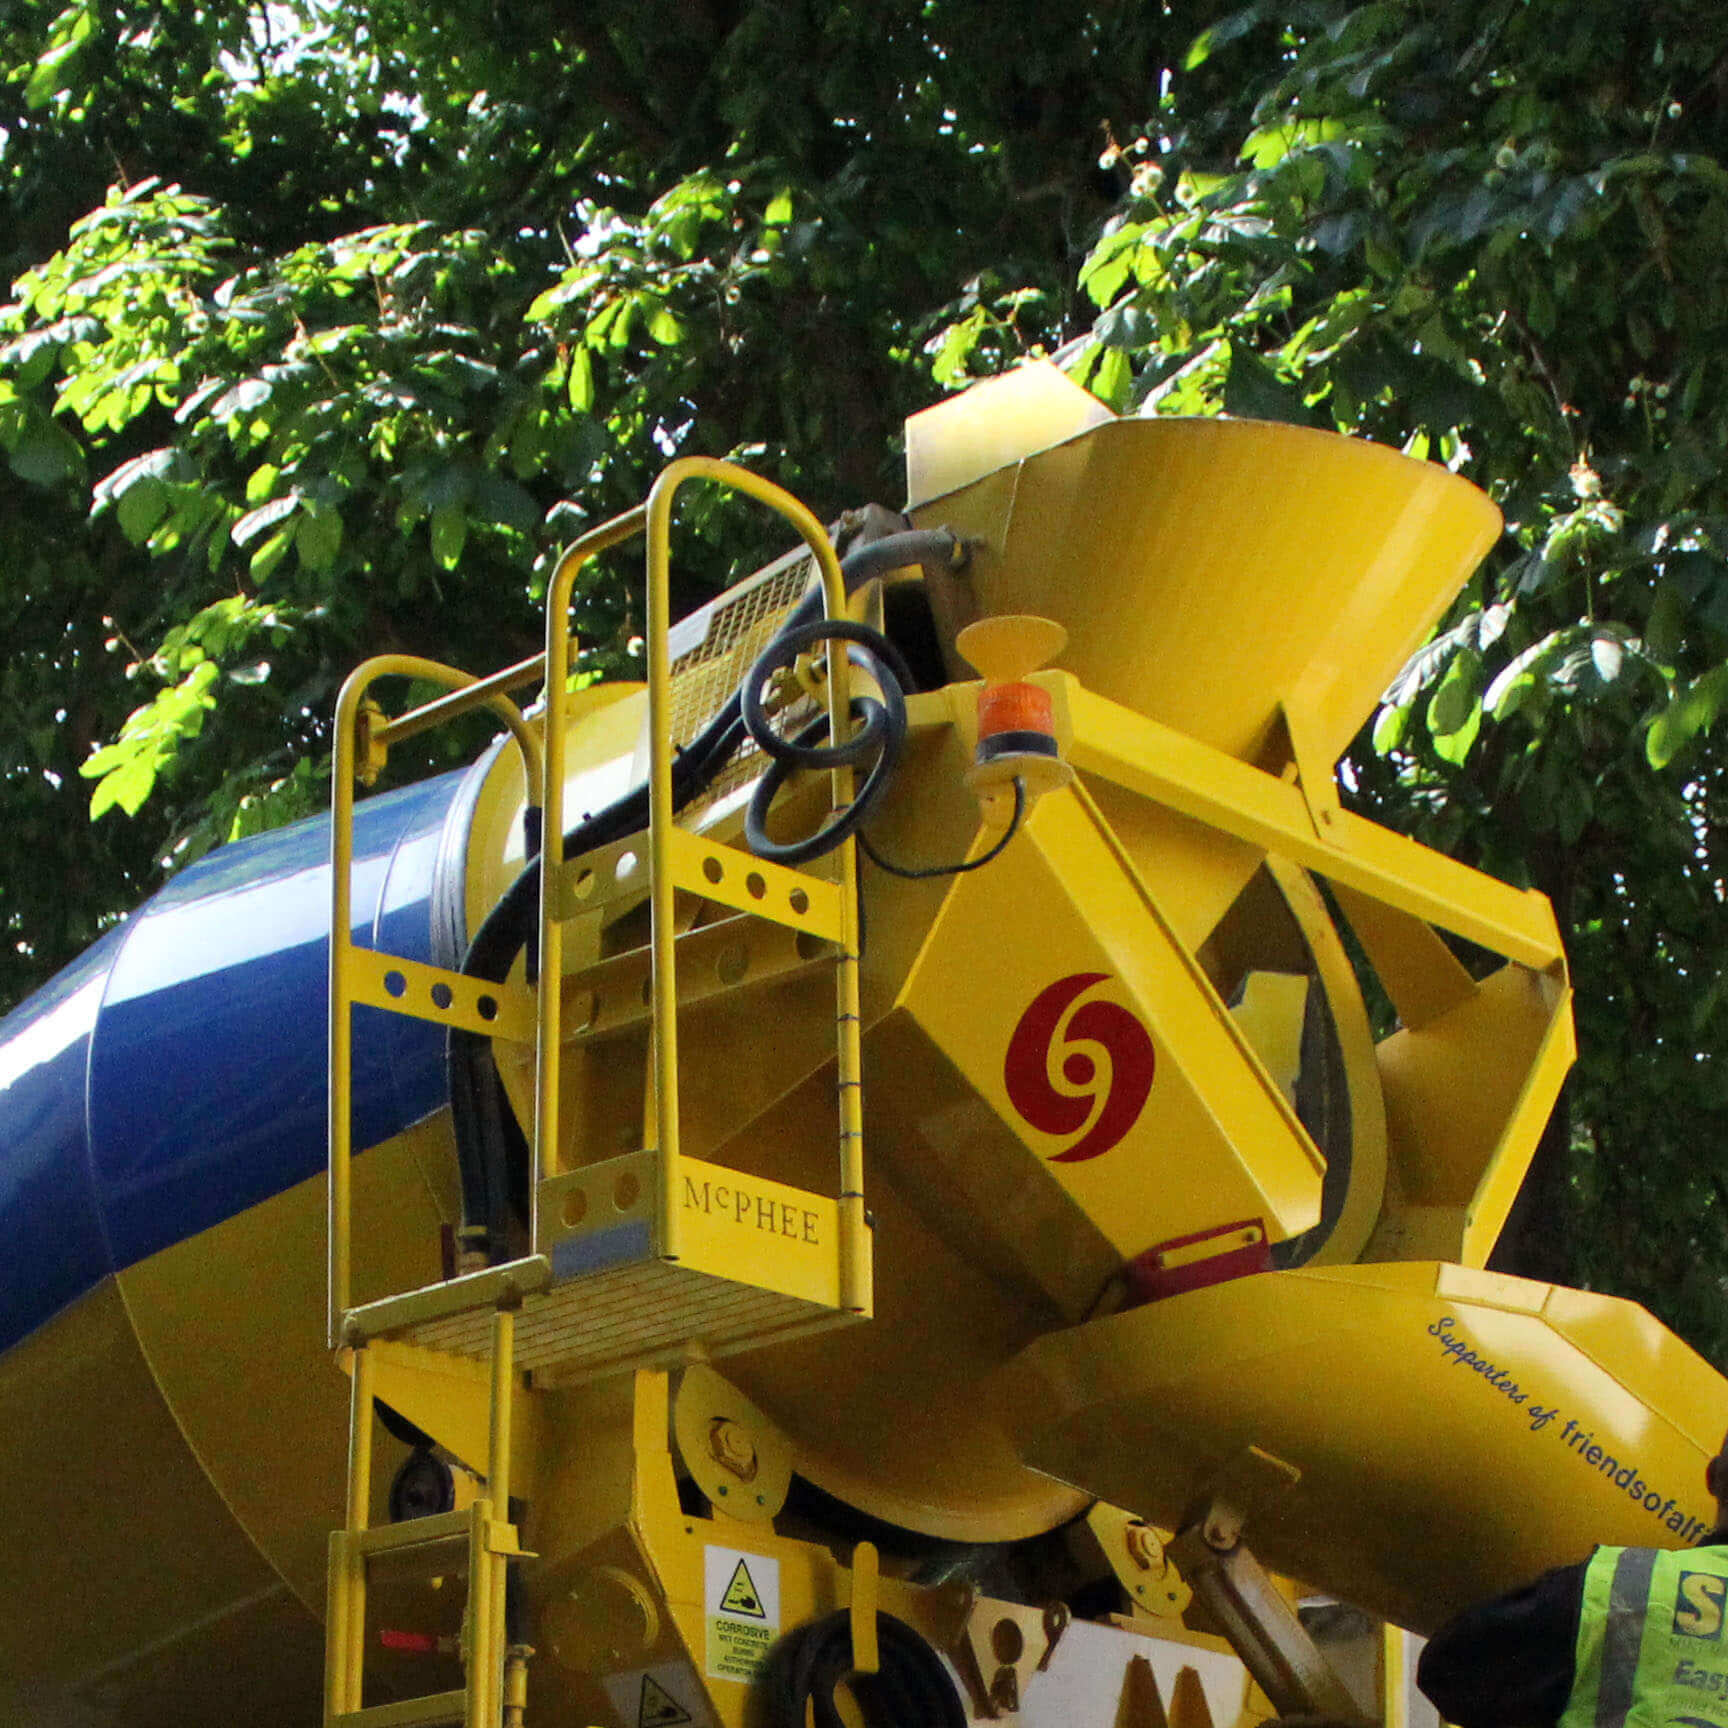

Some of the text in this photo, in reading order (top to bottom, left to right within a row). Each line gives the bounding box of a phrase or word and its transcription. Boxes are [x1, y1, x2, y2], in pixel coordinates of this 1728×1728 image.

[1428, 1317, 1529, 1404] Supporters
[1529, 1405, 1560, 1431] of
[715, 1620, 770, 1640] CORROSIVE
